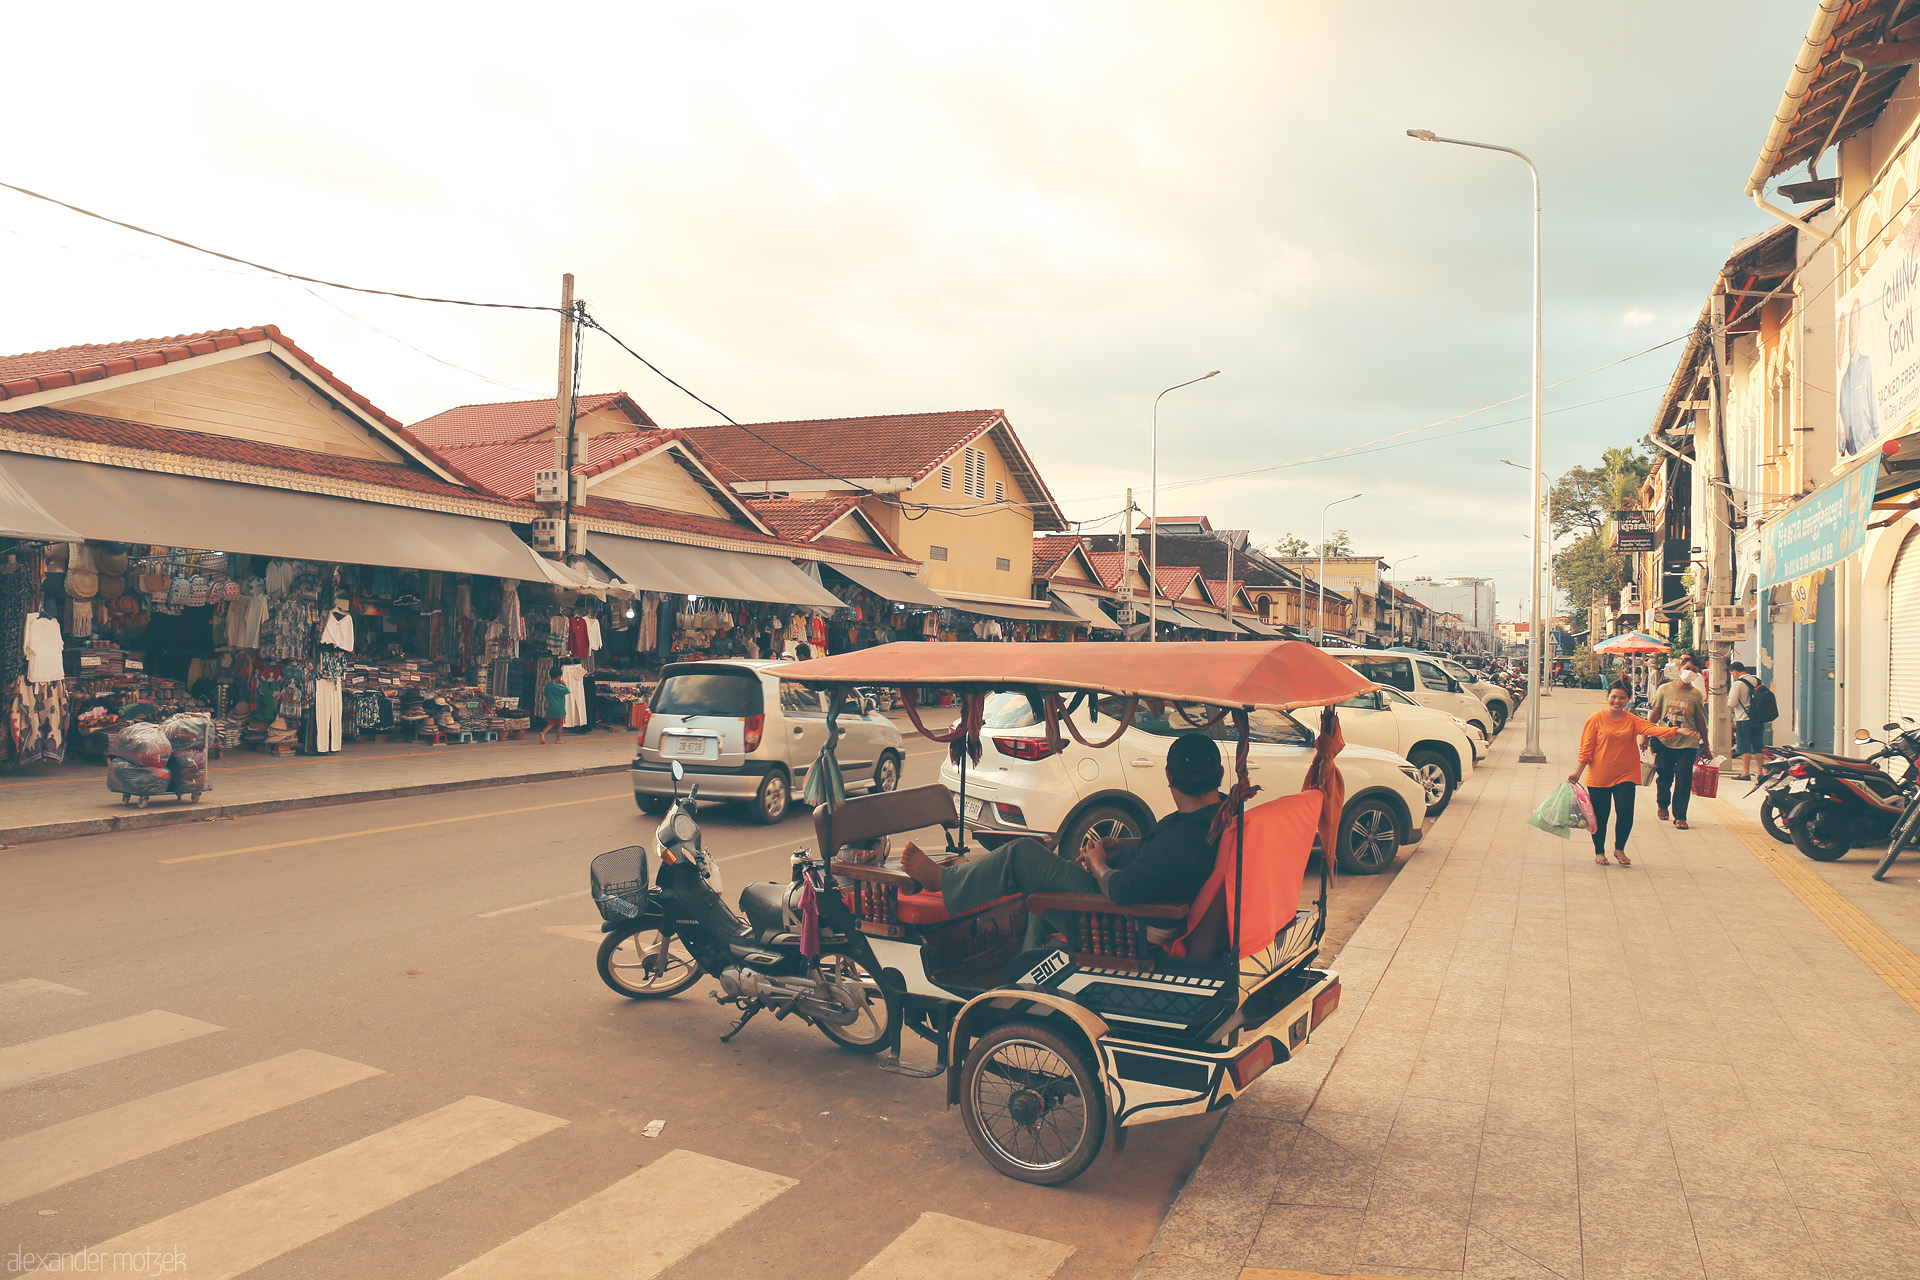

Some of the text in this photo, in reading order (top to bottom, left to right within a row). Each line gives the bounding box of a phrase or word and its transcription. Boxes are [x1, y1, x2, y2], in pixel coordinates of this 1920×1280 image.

[1882, 243, 1918, 322] COMING
[1889, 304, 1914, 367] SOON
[1031, 951, 1066, 985] 2017
